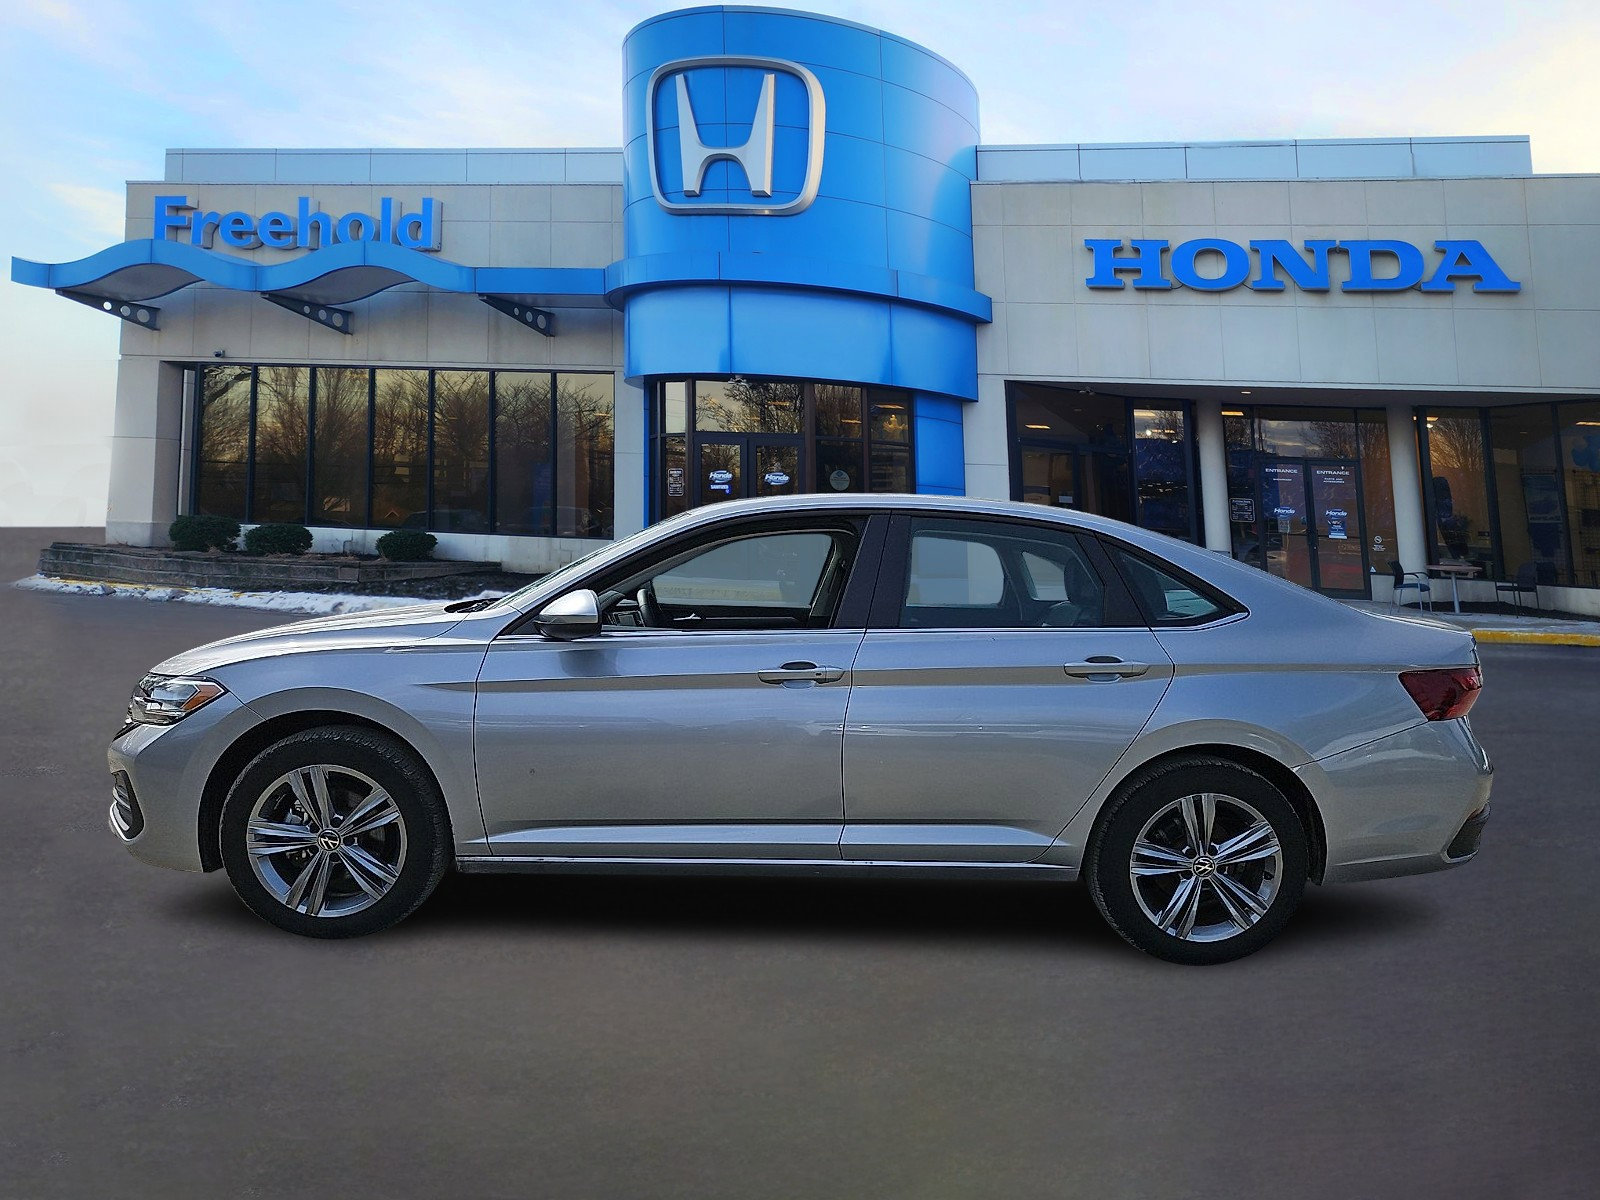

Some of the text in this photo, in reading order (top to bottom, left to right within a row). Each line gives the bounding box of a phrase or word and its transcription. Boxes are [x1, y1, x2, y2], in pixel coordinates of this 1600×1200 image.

[154, 195, 442, 250] Freehold
[1084, 237, 1521, 292] HONDA
[709, 471, 733, 480] Honda
[764, 473, 789, 481] Honda
[1274, 507, 1296, 515] Honda
